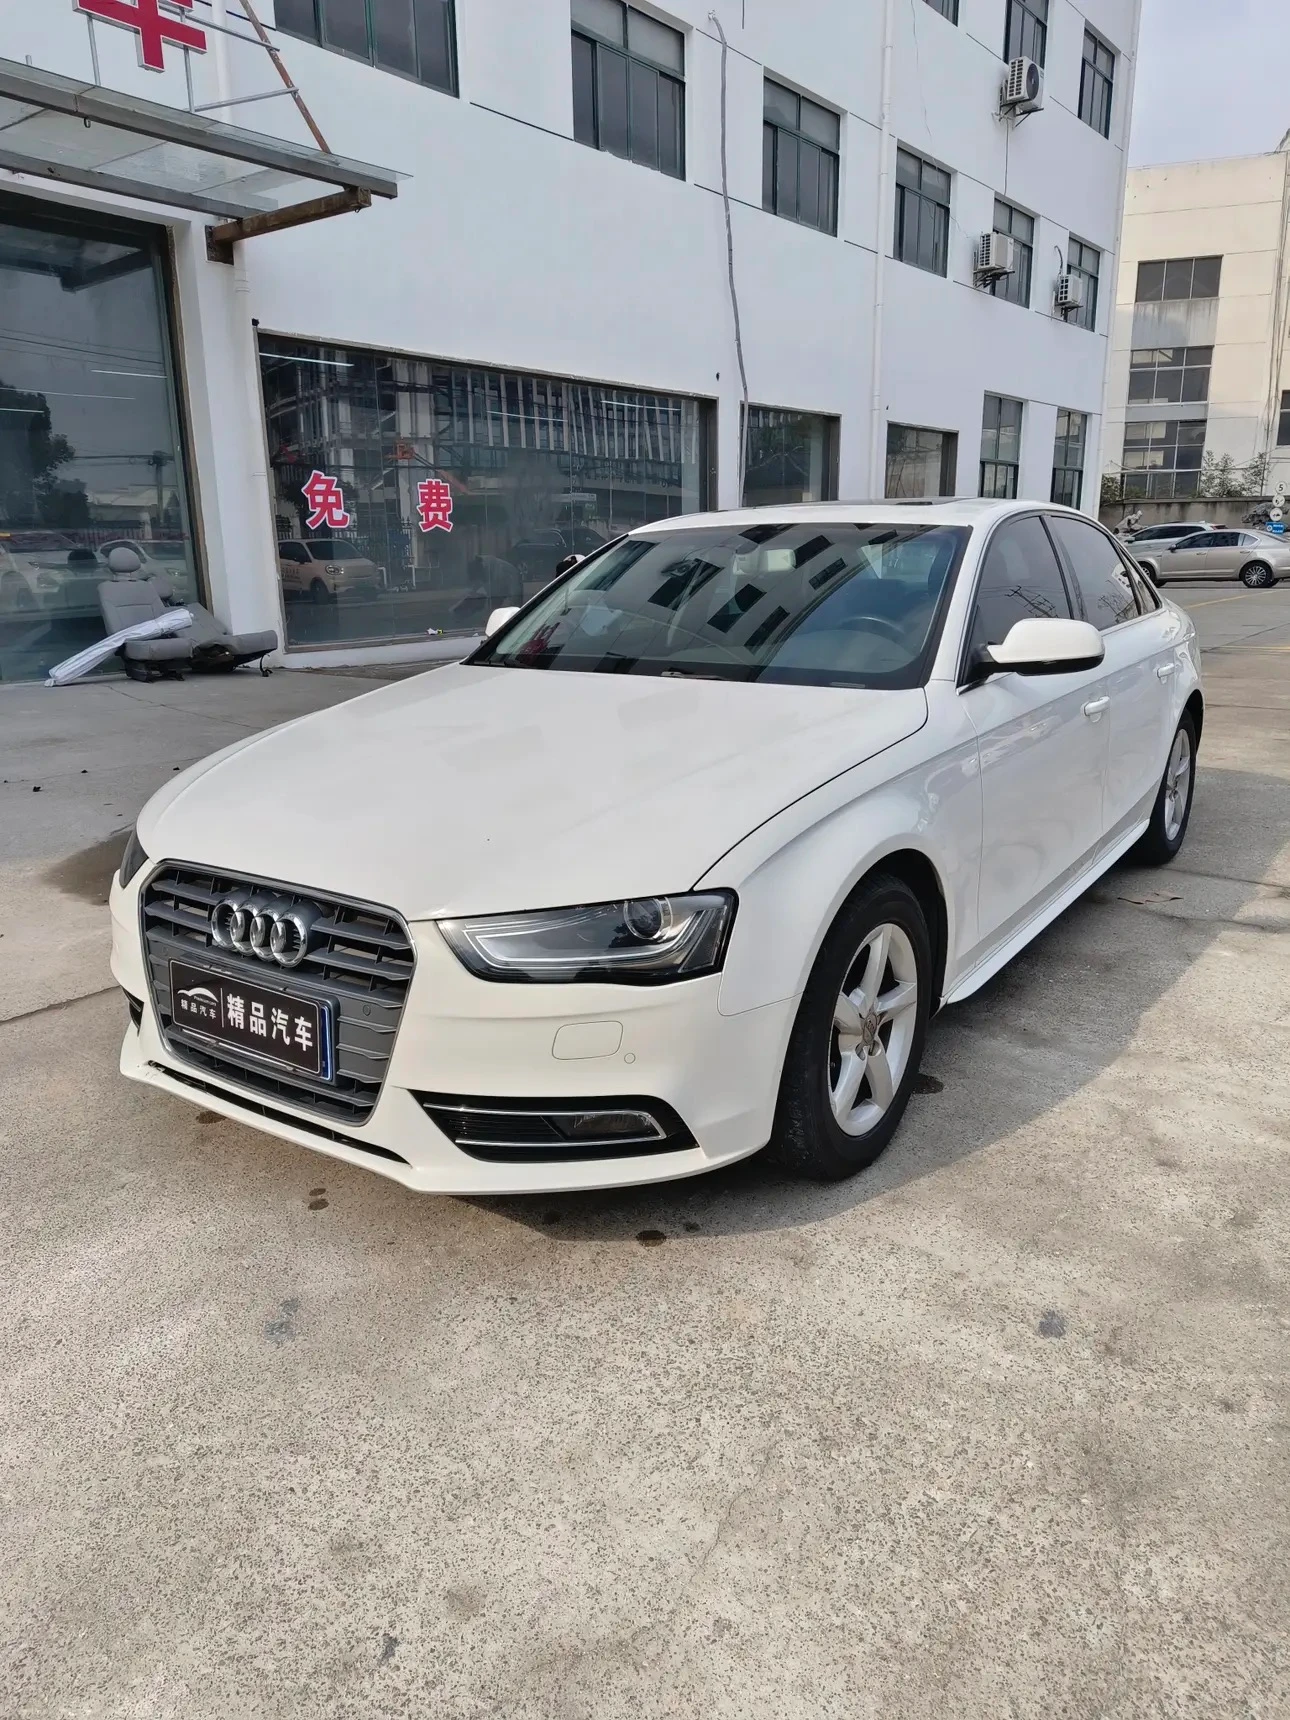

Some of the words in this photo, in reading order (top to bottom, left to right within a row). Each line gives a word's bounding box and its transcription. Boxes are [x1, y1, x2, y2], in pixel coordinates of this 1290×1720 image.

[301, 470, 453, 532] 免费
[226, 993, 313, 1052] 精品汽车
